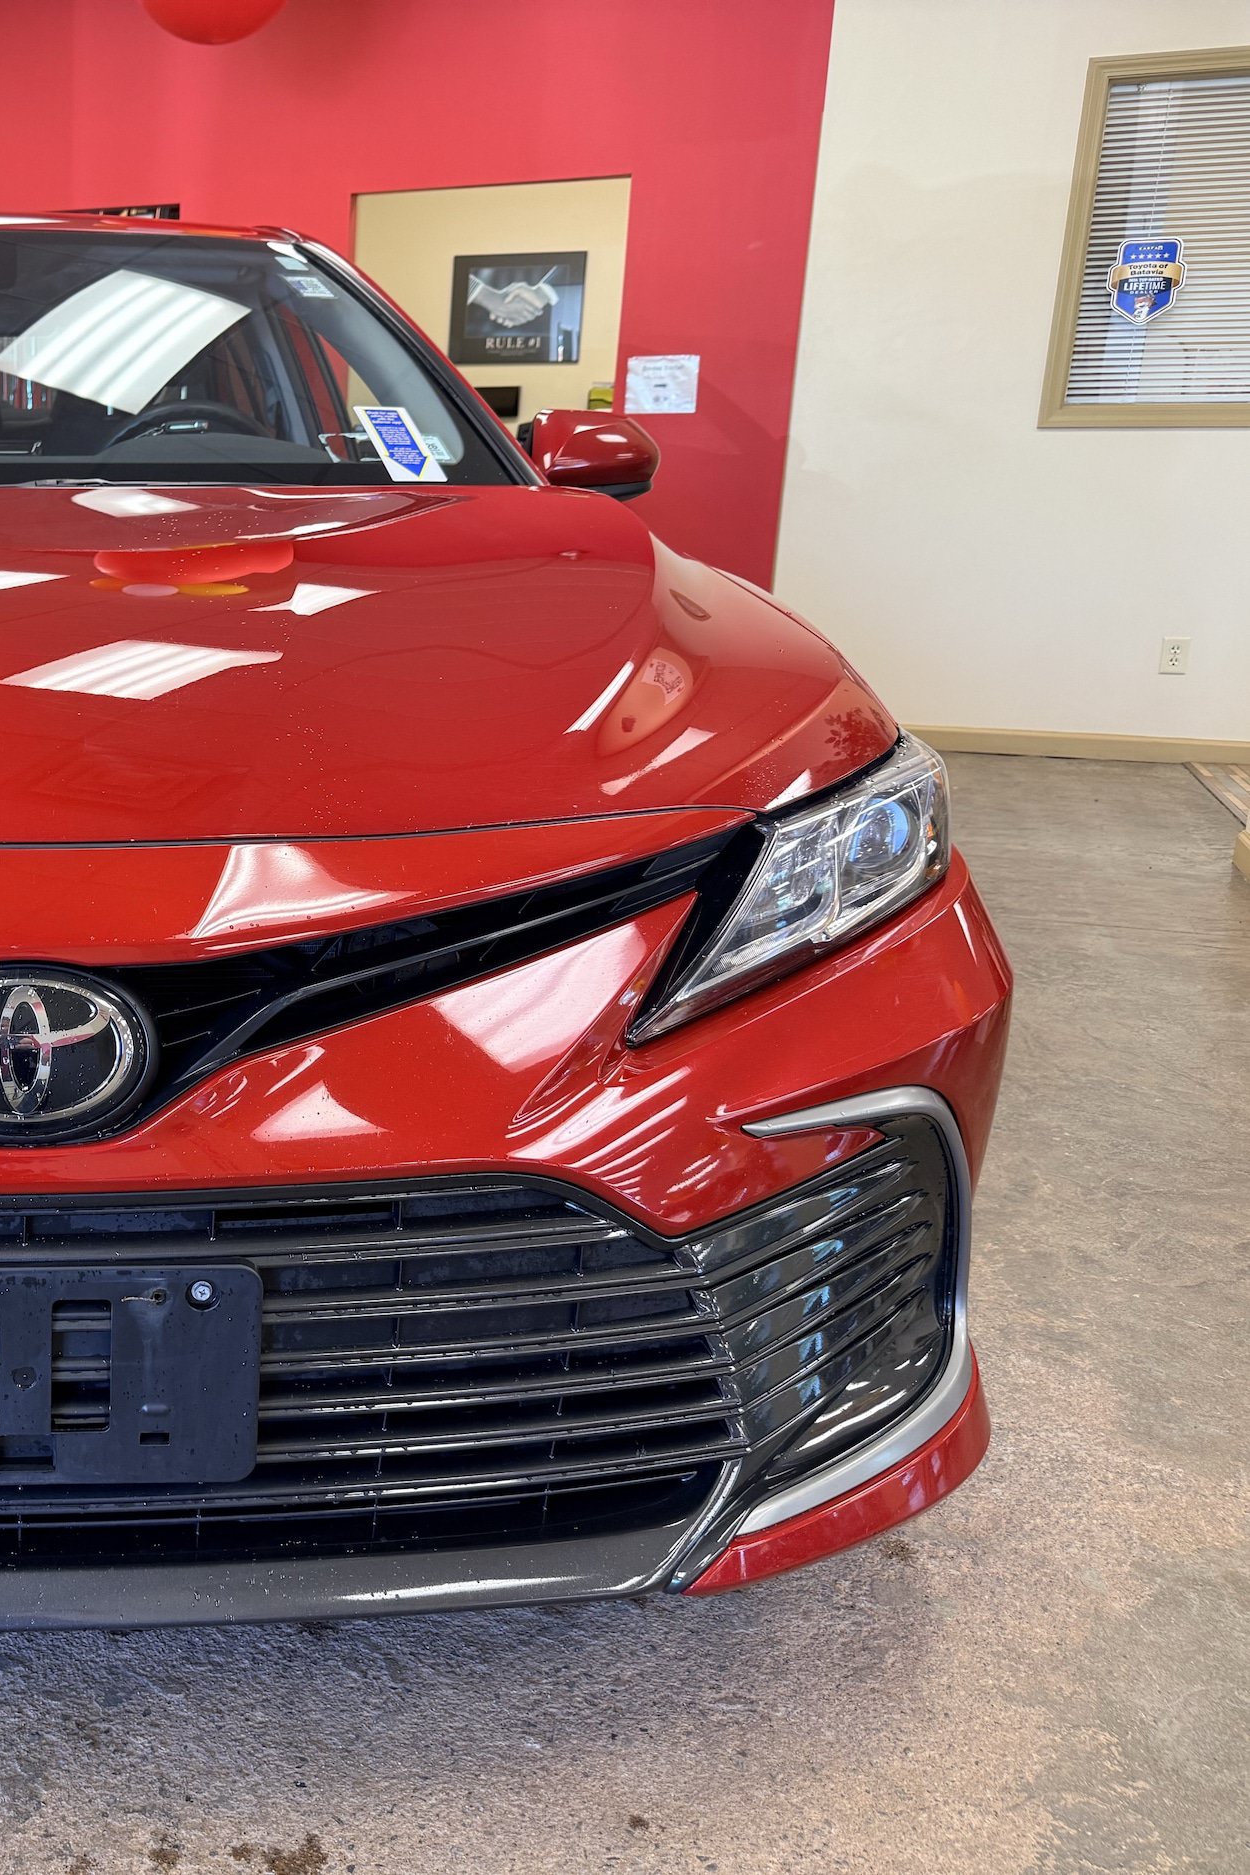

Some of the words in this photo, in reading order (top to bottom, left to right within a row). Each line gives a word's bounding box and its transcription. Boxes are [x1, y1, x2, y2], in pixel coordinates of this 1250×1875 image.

[1124, 282, 1166, 291] LIFETIME
[485, 337, 525, 349] RULE
[528, 336, 541, 348] #1
